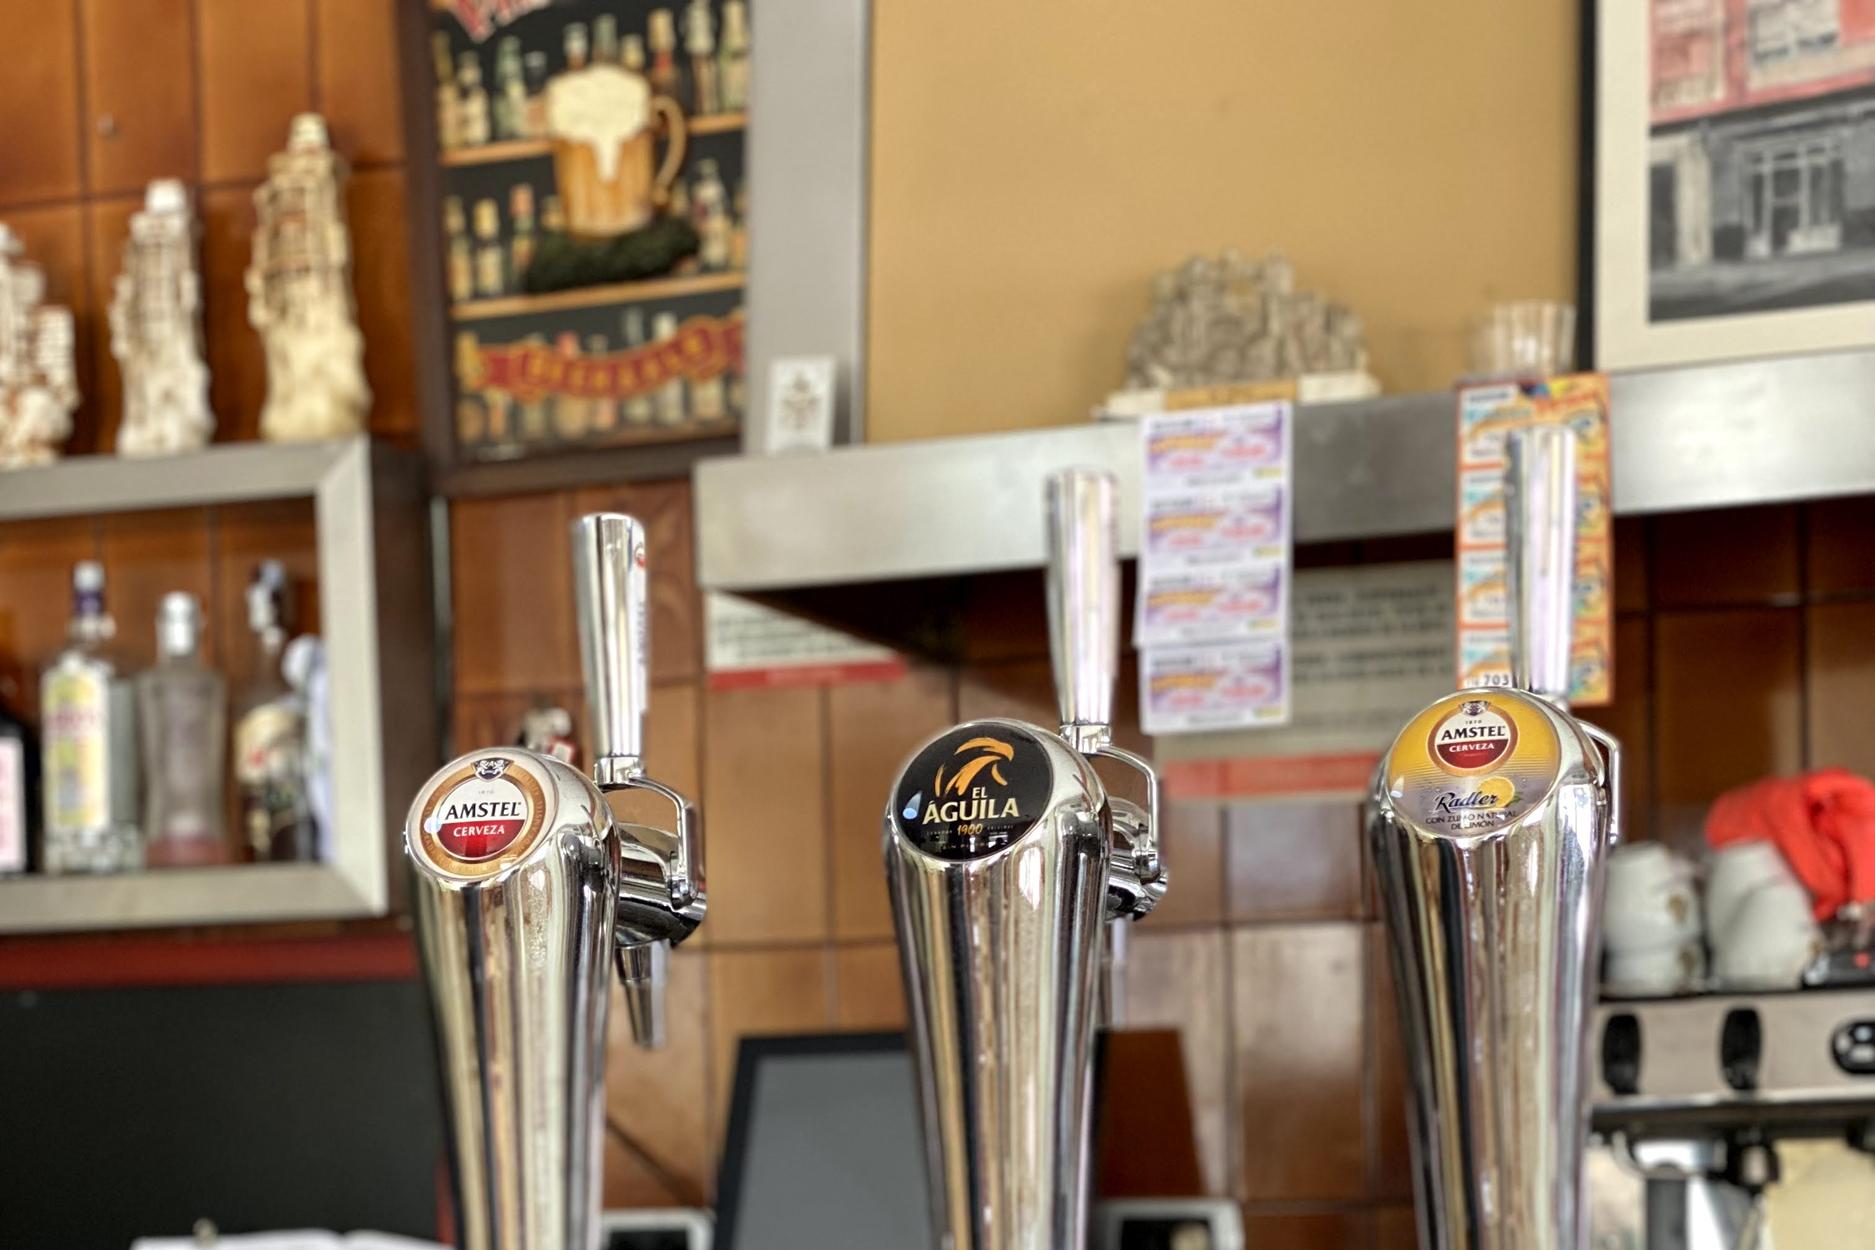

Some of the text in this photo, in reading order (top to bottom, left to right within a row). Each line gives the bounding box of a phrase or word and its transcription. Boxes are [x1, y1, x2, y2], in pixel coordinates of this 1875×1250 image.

[1441, 726, 1505, 741] AMSTEL
[1449, 743, 1495, 753] CERVEZA
[972, 786, 988, 799] EL
[1435, 791, 1498, 813] Radler
[445, 802, 521, 820] AMSTEL
[922, 797, 1019, 825] ÁGUILA
[1425, 816, 1445, 825] CON
[453, 824, 505, 837] CERVEZA
[957, 823, 984, 837] 1900
